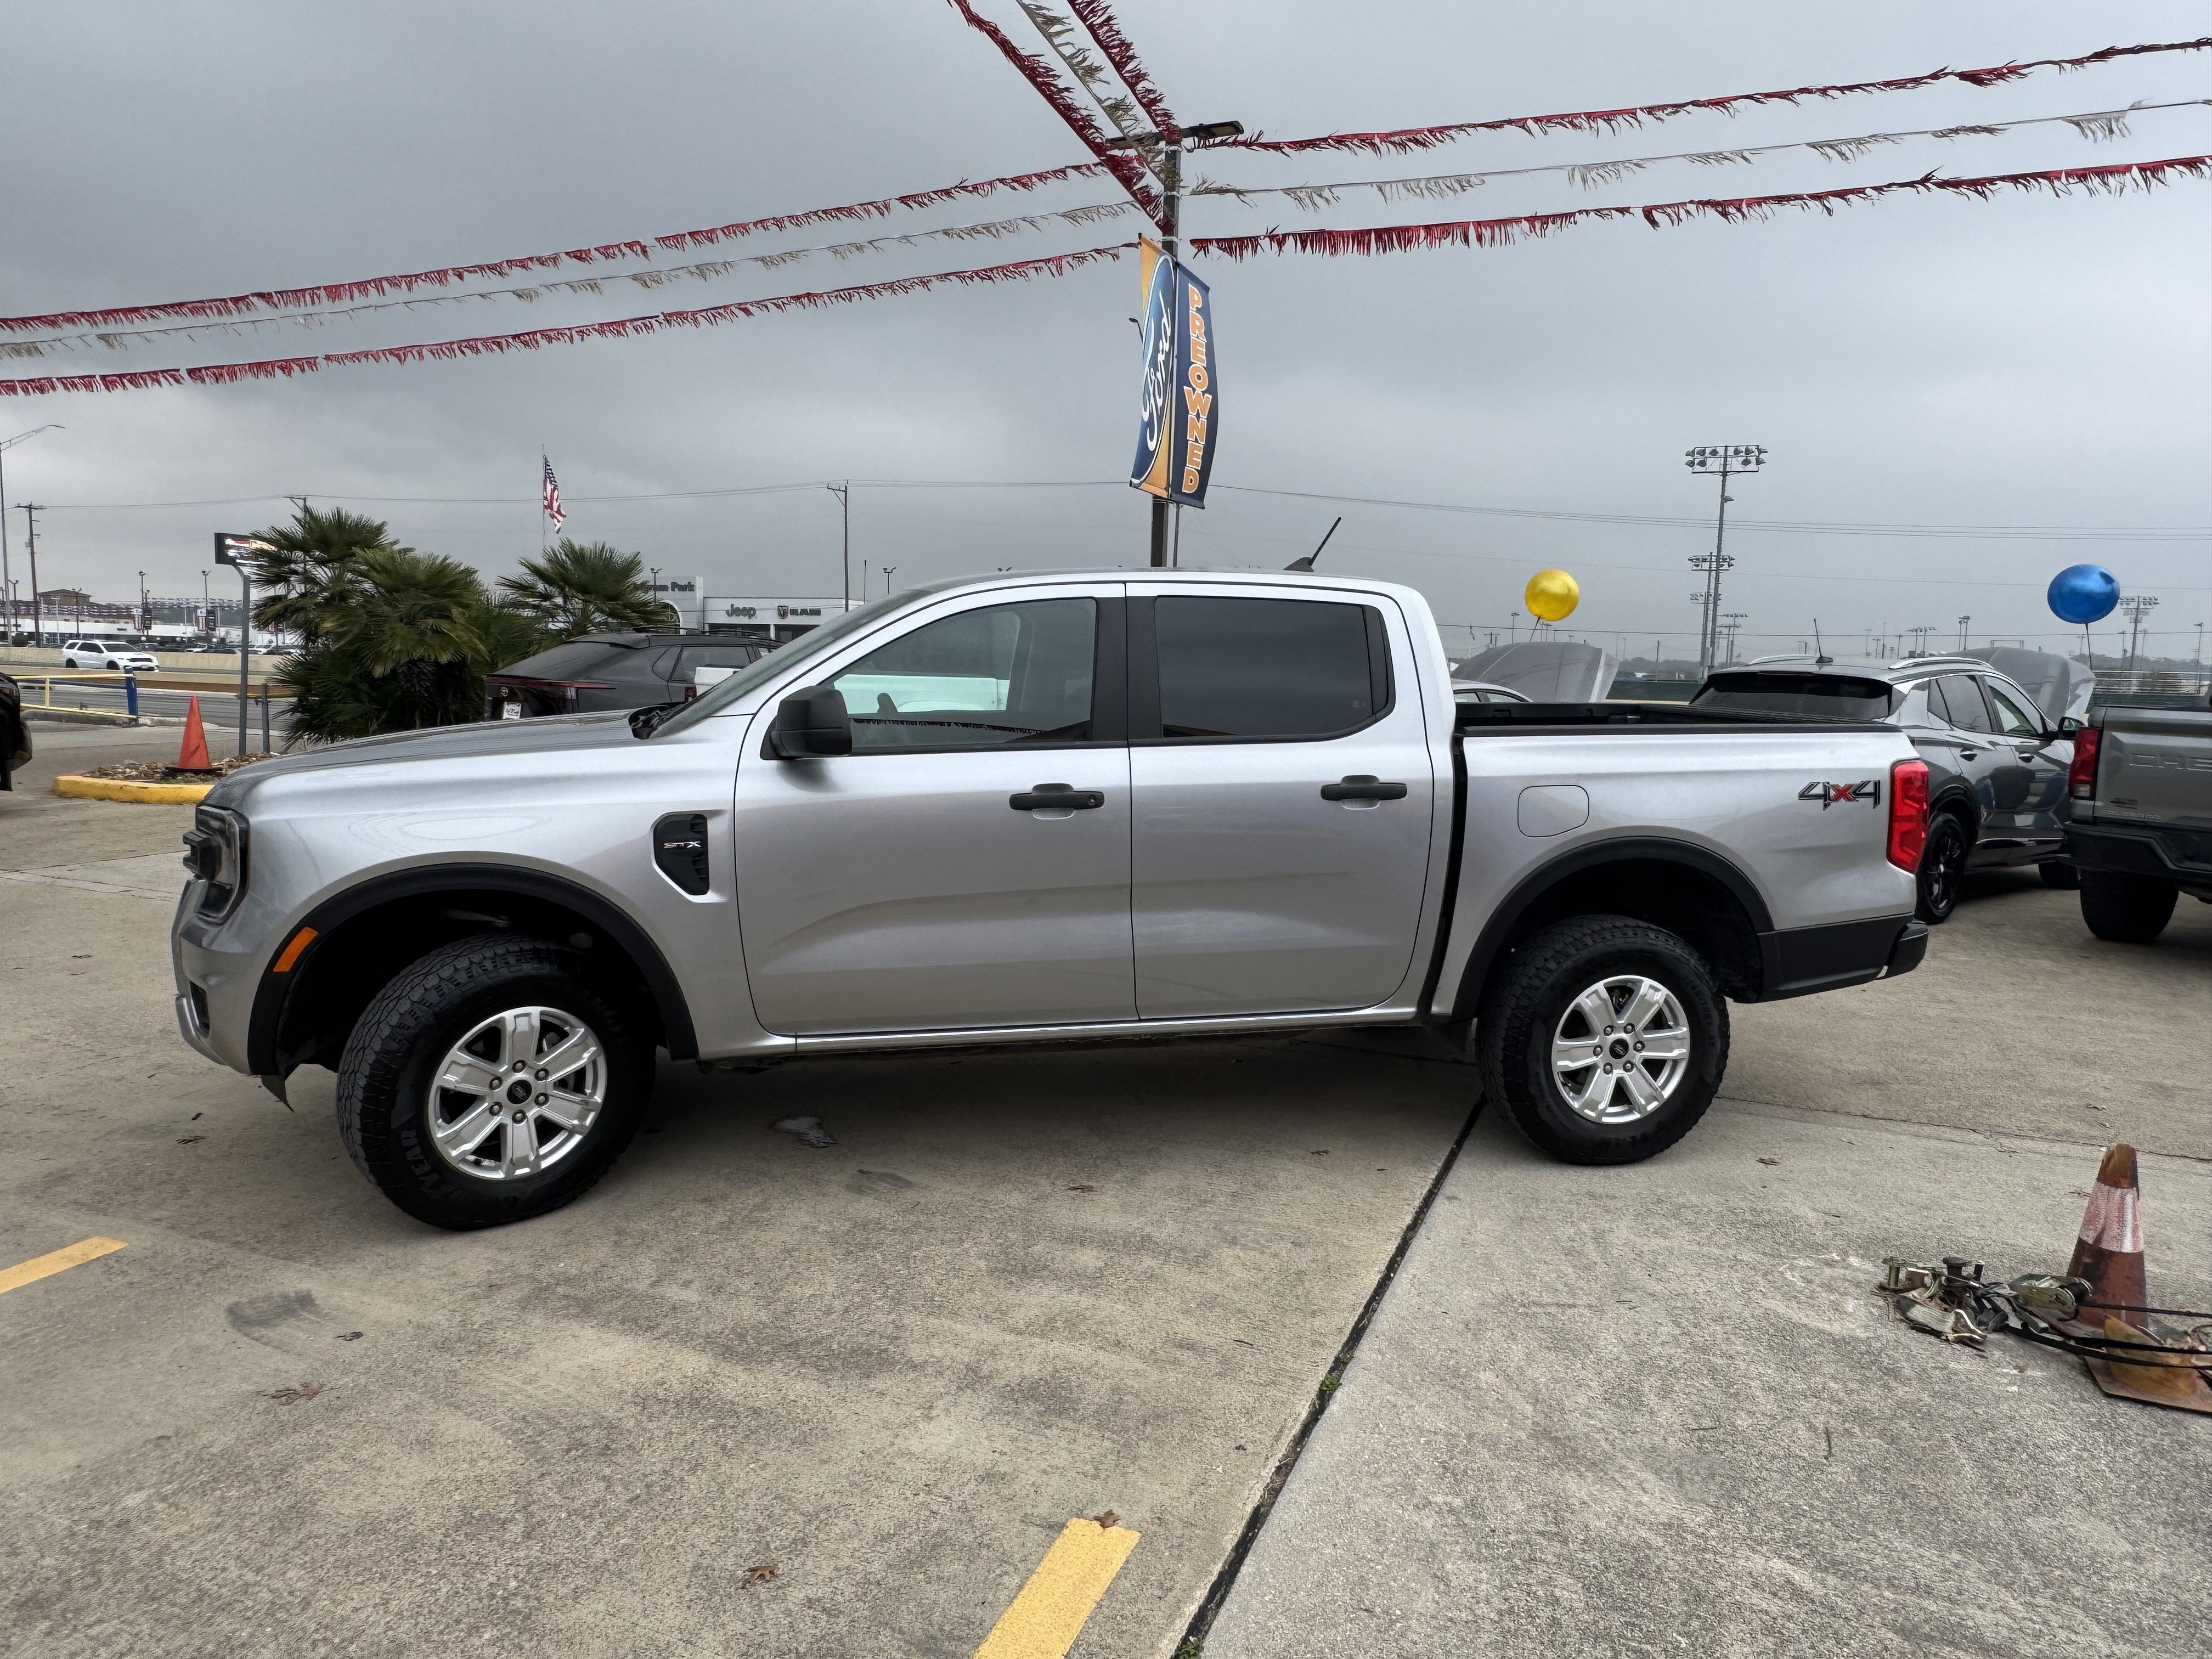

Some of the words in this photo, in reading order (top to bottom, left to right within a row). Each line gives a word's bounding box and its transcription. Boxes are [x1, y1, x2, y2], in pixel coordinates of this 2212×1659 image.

[1142, 289, 1171, 452] Ford
[1183, 283, 1212, 493] PREOWNED
[671, 582, 695, 591] Park
[725, 603, 757, 619] Jeep
